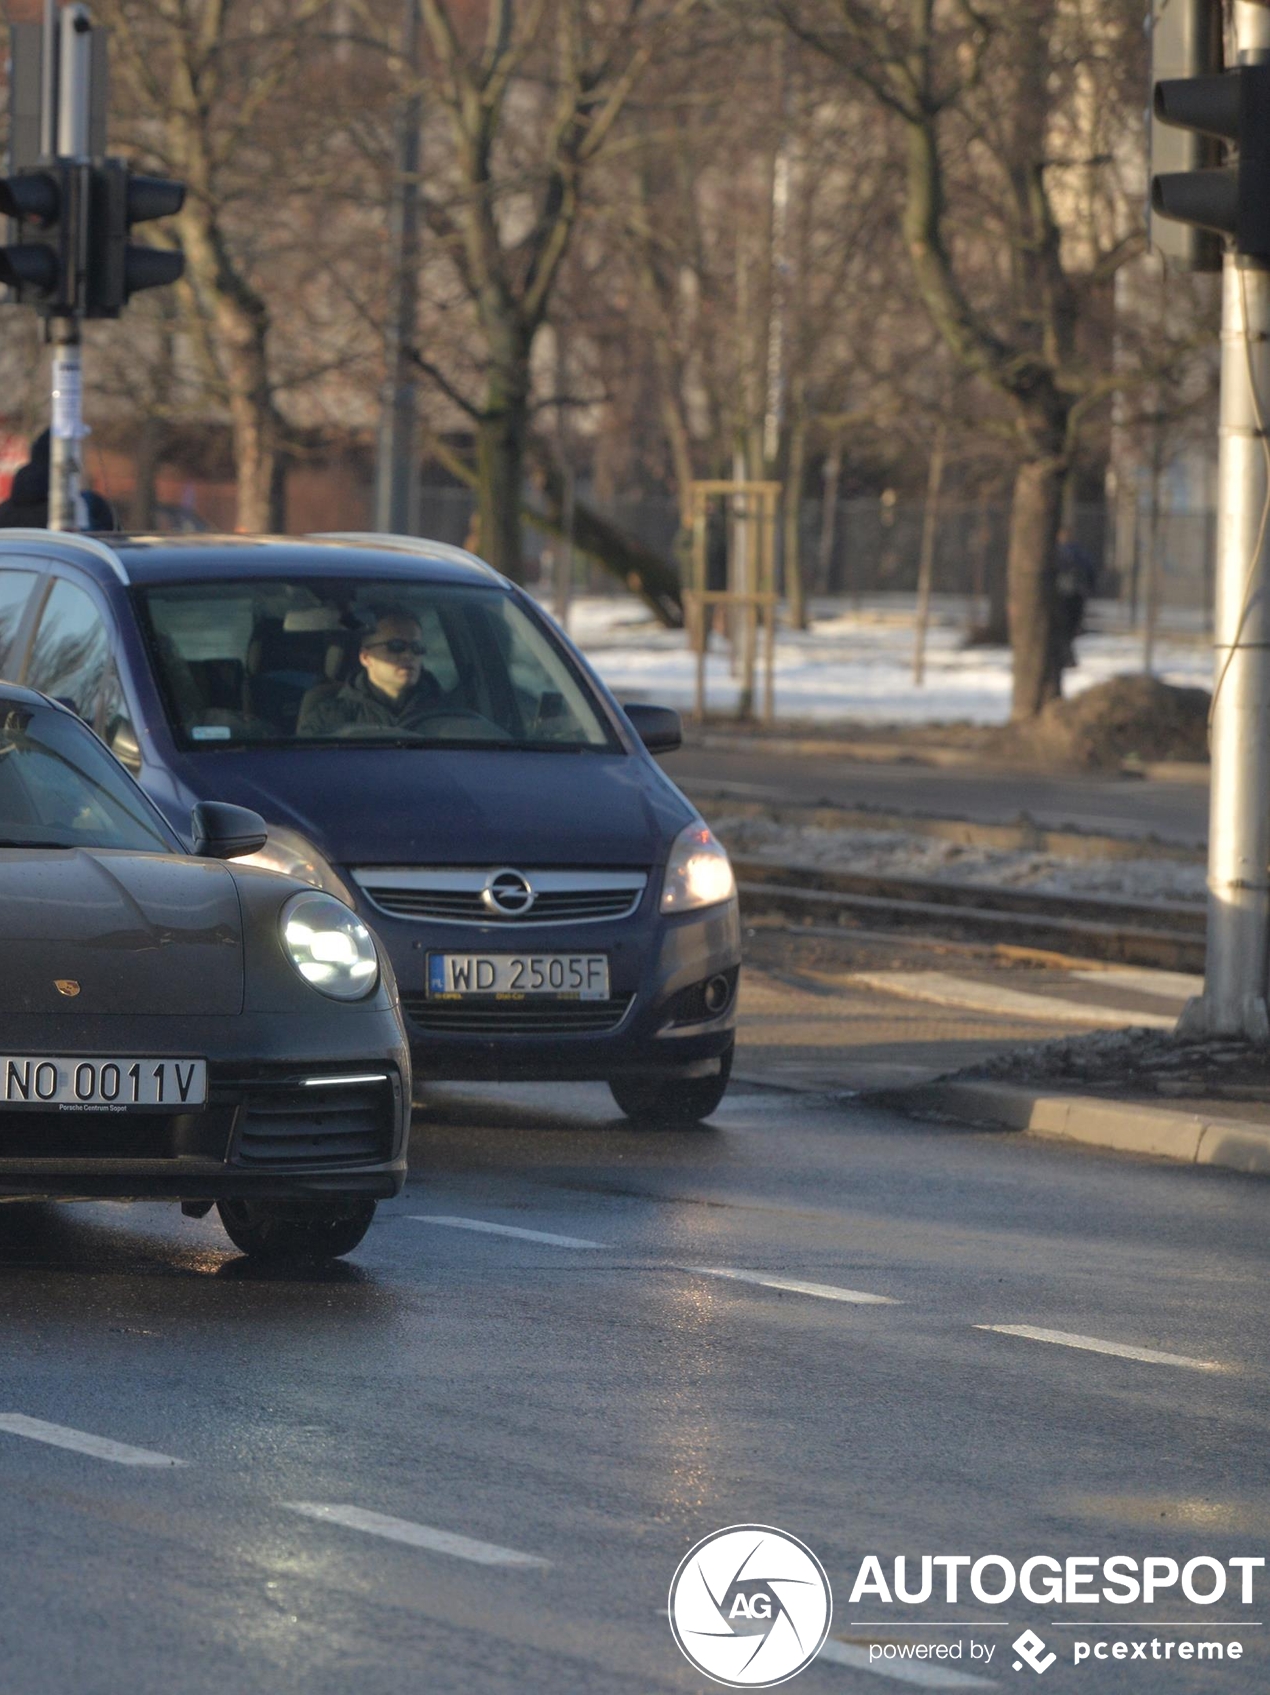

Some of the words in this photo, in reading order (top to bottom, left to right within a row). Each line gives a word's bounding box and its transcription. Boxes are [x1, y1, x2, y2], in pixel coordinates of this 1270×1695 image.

[451, 958, 496, 990] WD
[509, 958, 604, 990] 2505F
[5, 1061, 58, 1100] NO
[73, 1062, 196, 1103] 0011V
[83, 1104, 109, 1112] Centrum
[109, 1104, 127, 1113] Sopot
